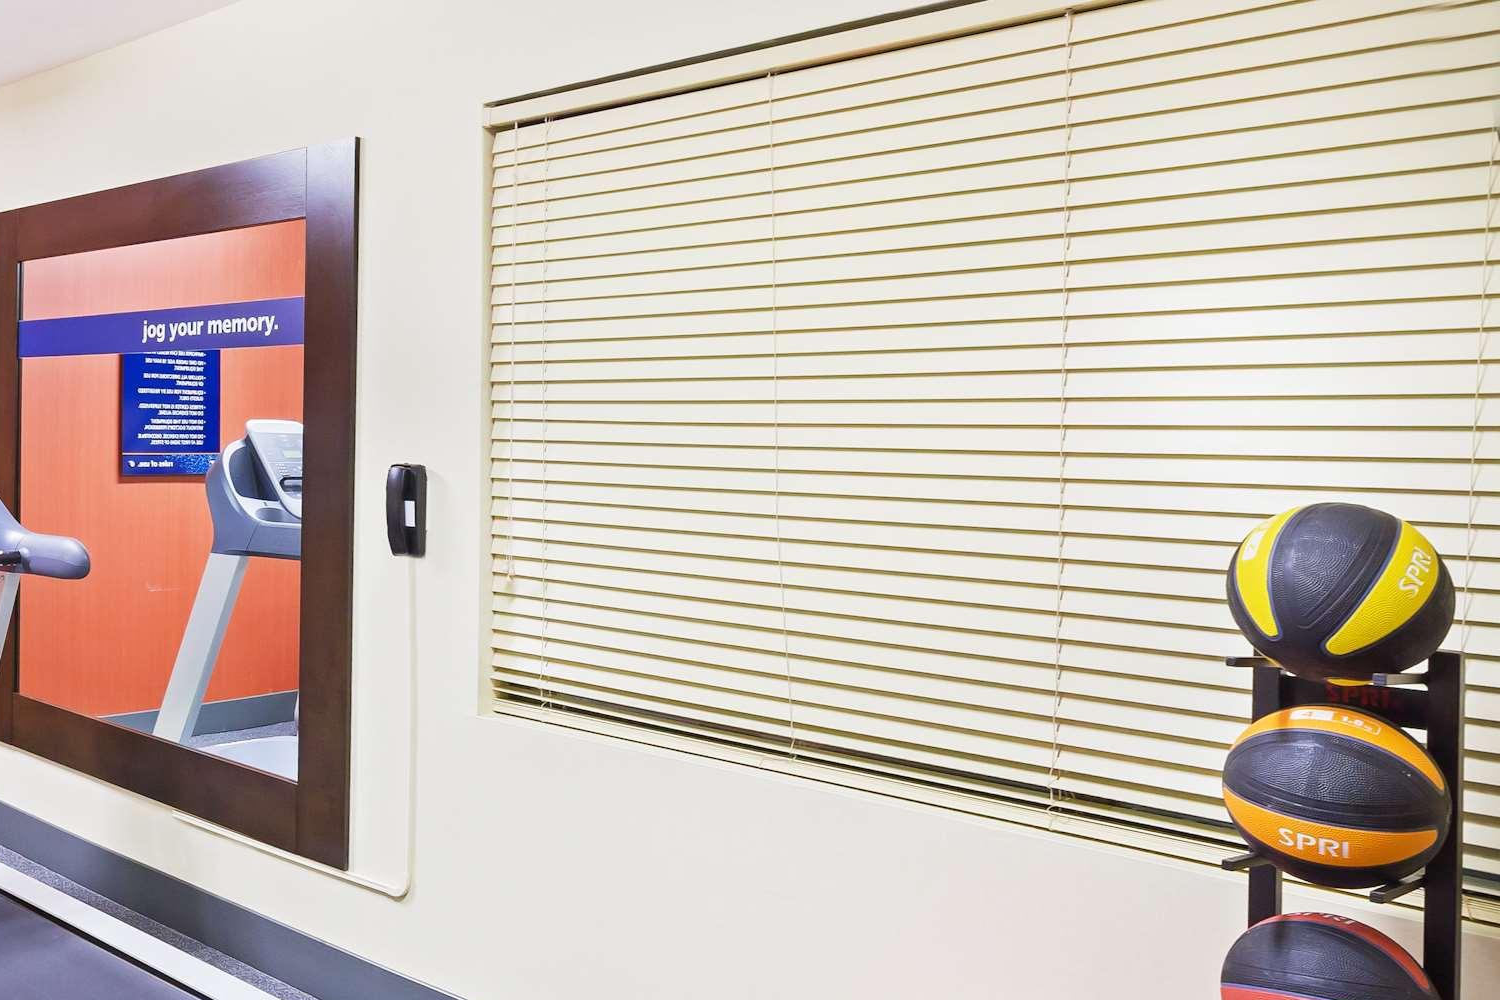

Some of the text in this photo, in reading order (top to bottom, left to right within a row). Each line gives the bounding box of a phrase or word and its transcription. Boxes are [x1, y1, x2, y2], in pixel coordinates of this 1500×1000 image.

[142, 315, 278, 343] jog your memory.
[1399, 545, 1431, 598] SPRI
[1279, 828, 1349, 858] SPRI
